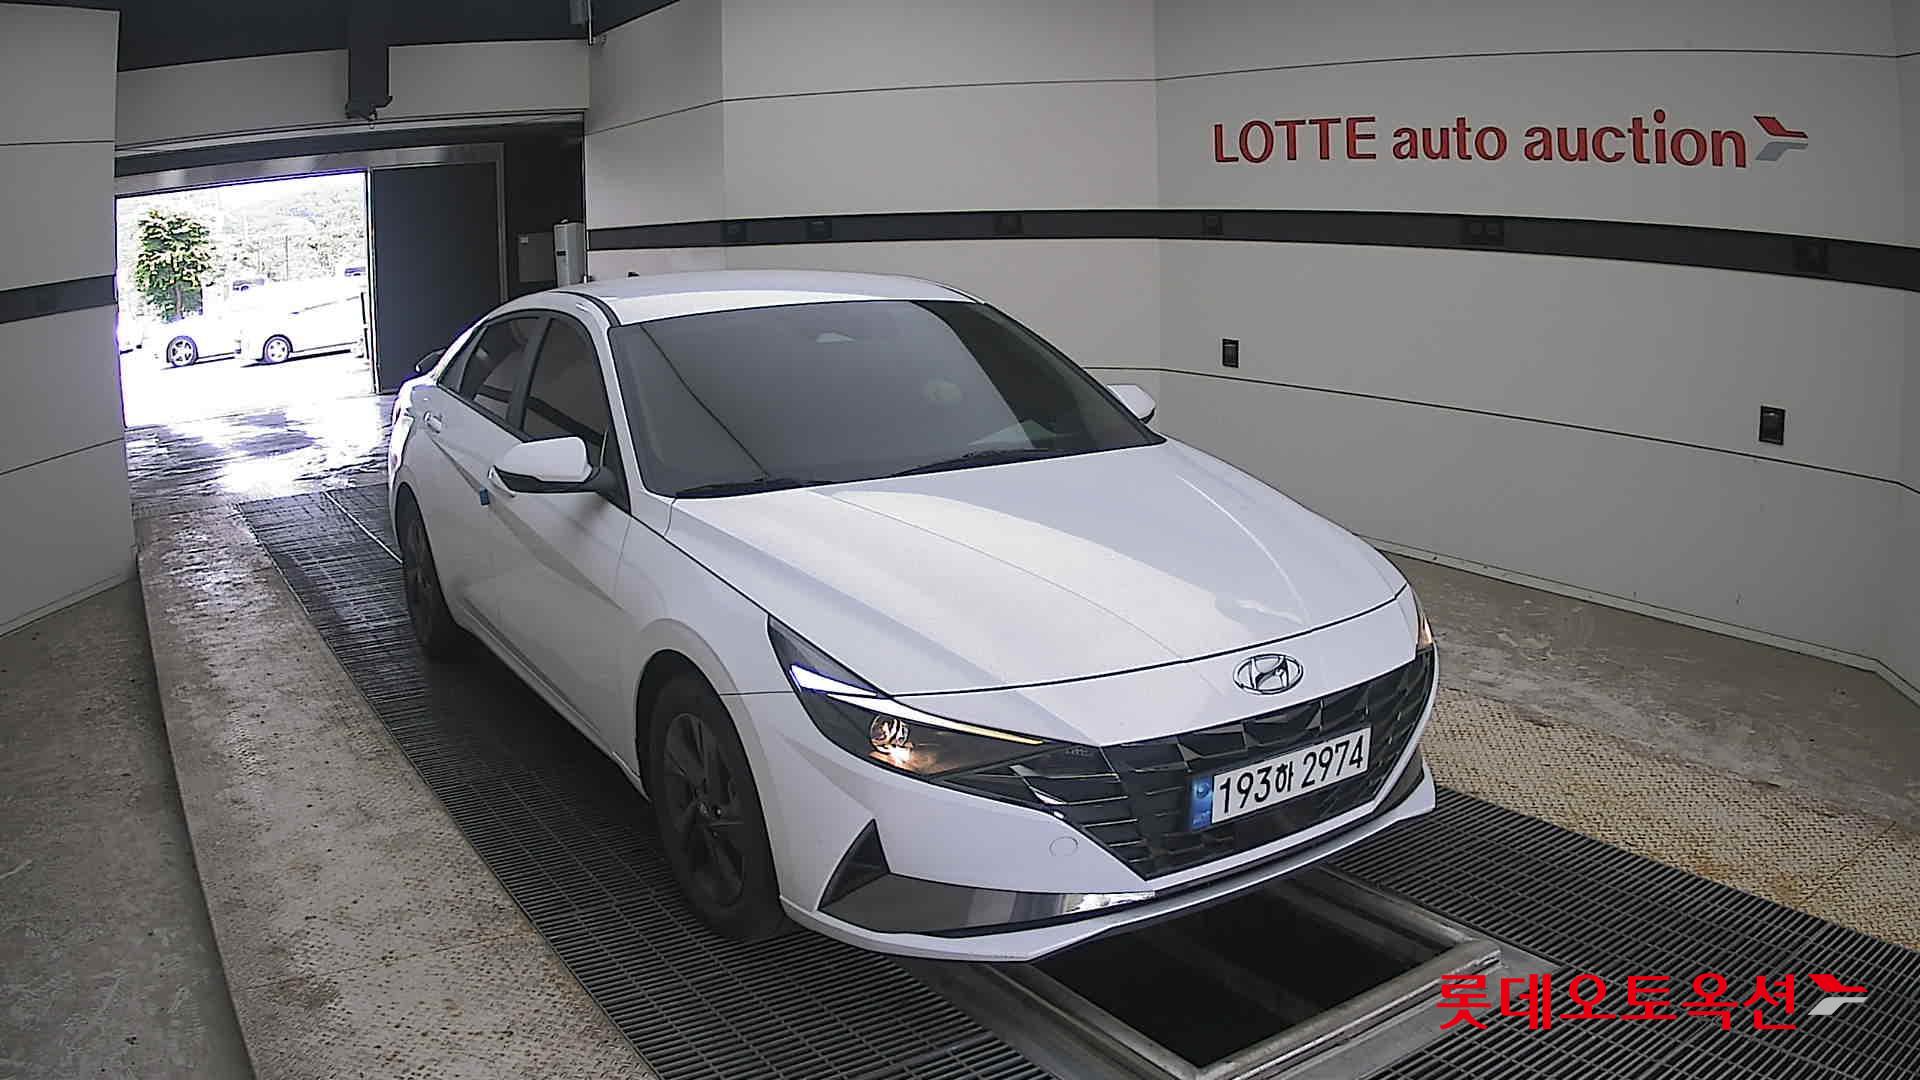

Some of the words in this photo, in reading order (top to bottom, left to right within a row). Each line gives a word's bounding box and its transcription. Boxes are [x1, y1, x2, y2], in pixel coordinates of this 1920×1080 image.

[1213, 116, 1378, 163] LOTTE
[1392, 116, 1508, 161] auto
[1523, 108, 1748, 169] auction
[1219, 760, 1294, 813] 193하
[1301, 735, 1364, 788] 2974
